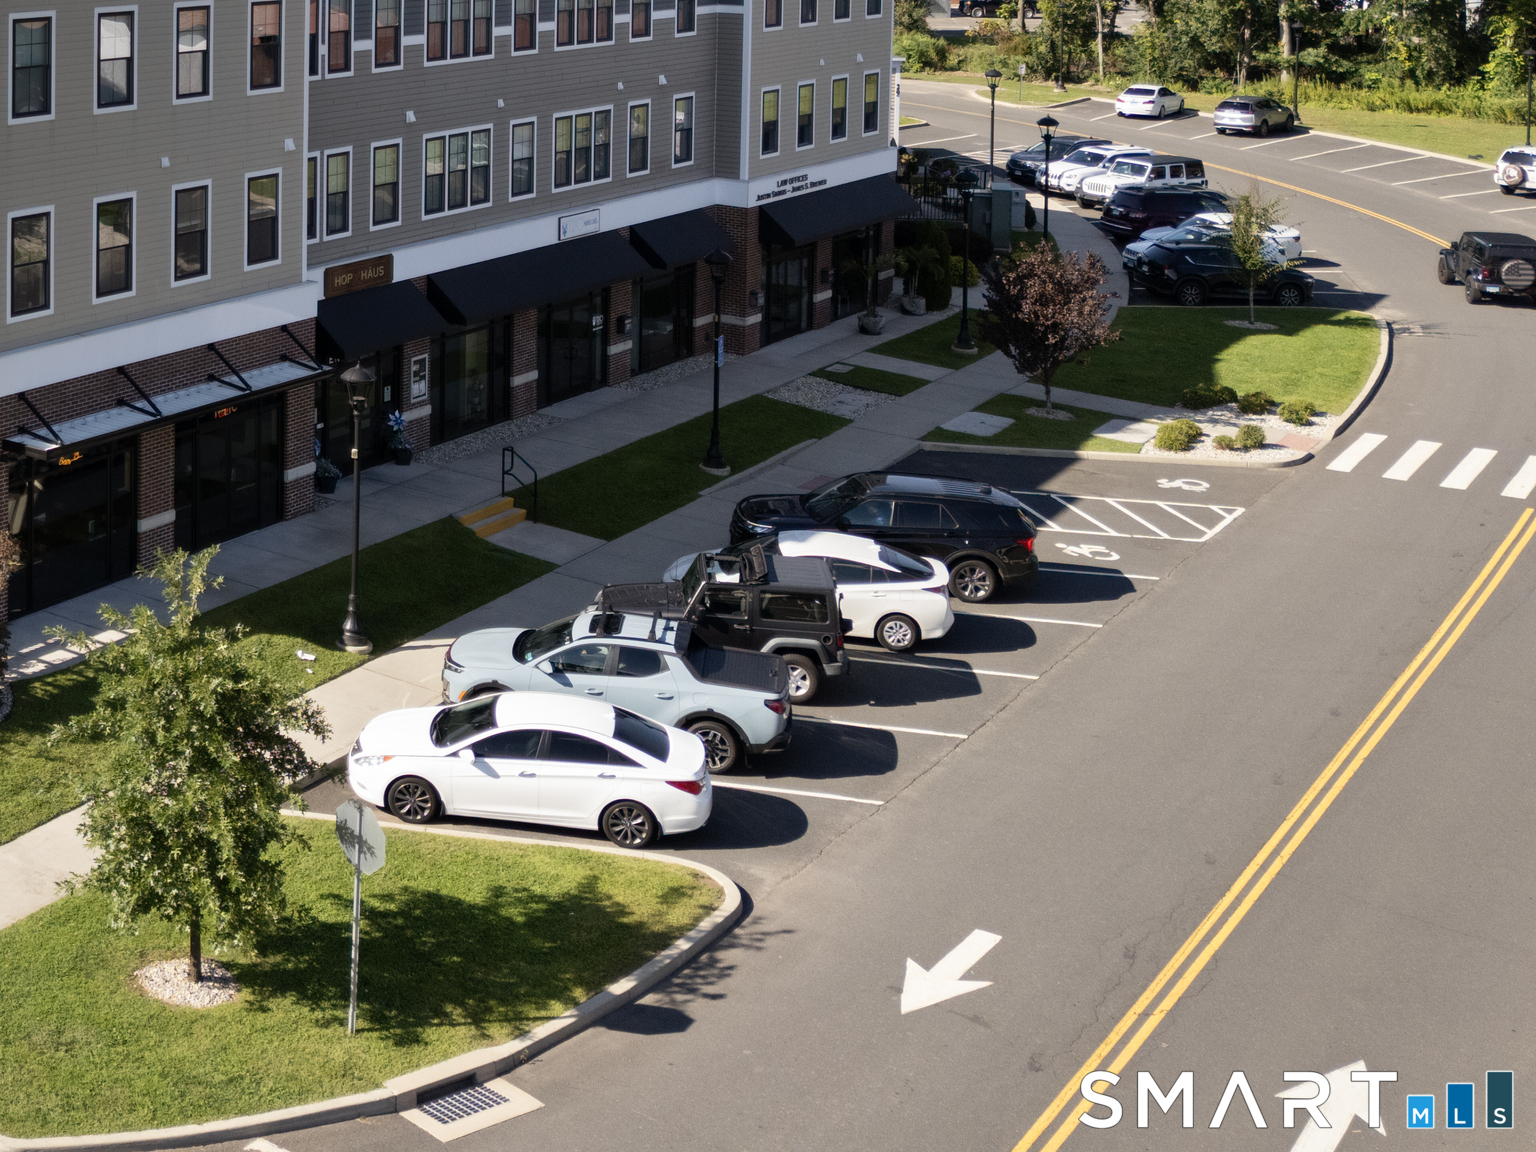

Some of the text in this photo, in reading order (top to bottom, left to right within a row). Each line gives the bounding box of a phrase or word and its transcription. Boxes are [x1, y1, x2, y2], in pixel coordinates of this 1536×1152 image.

[777, 174, 808, 188] LAW OFFICES
[334, 273, 354, 287] HOP
